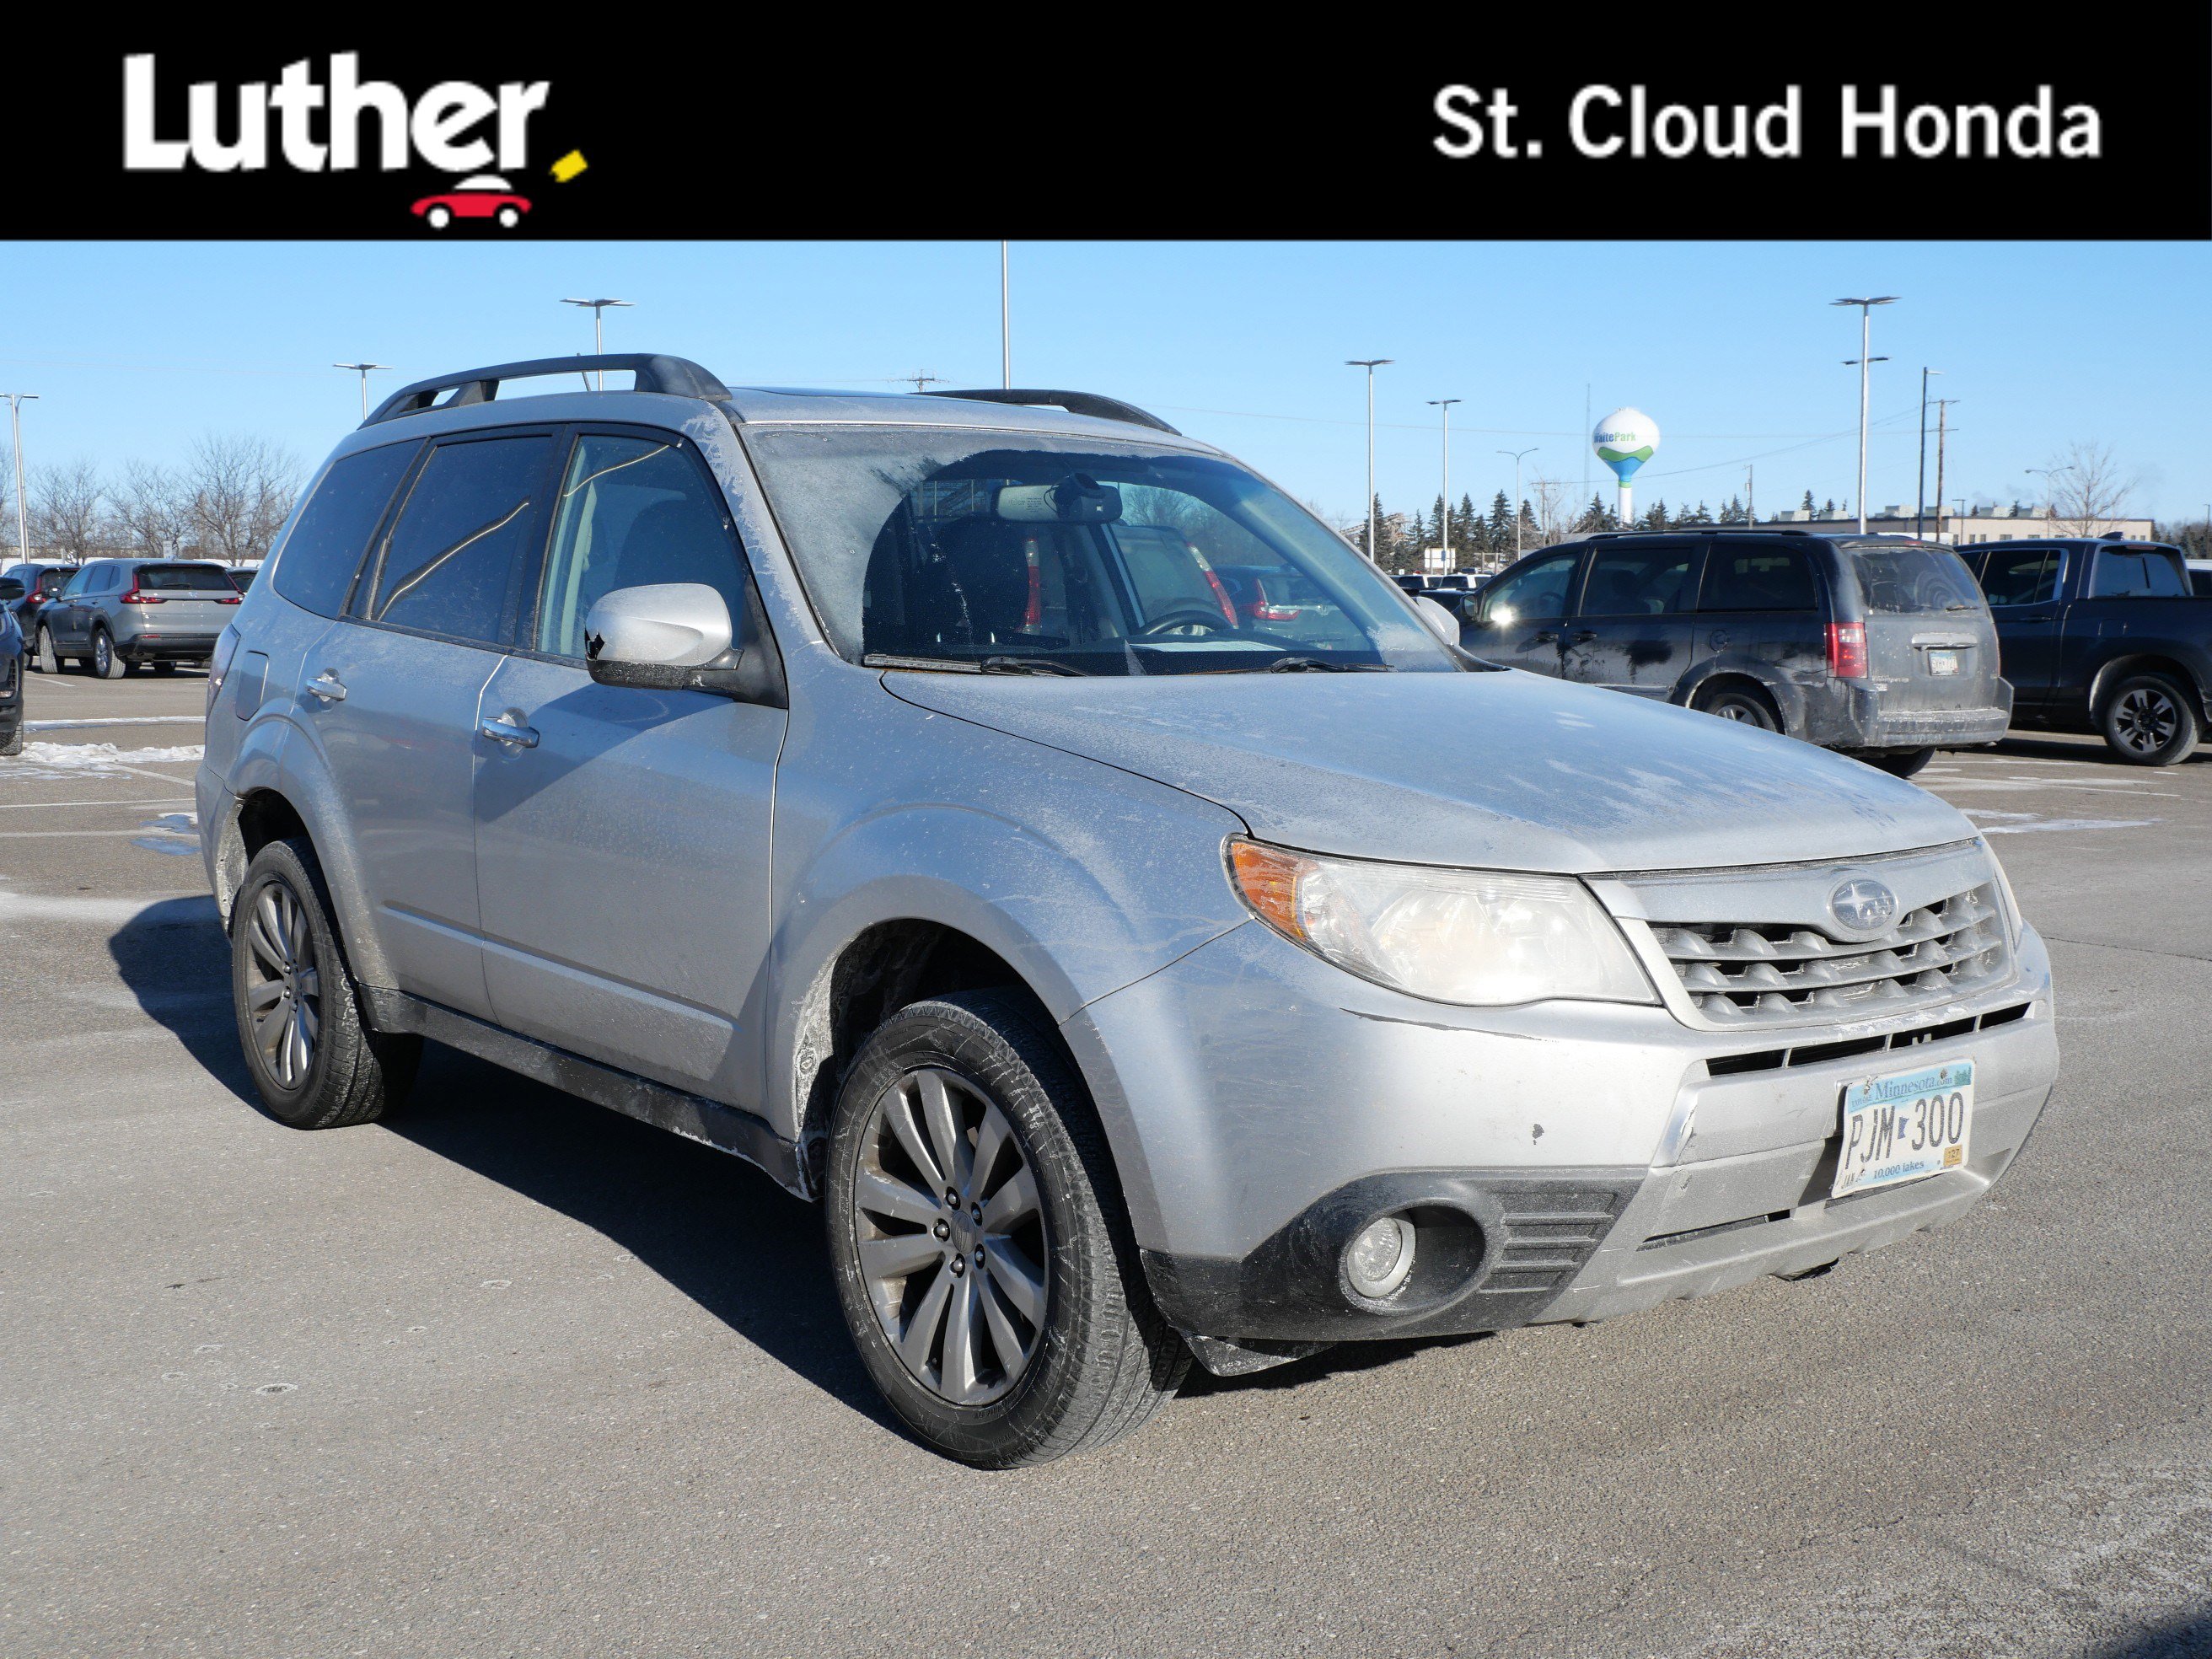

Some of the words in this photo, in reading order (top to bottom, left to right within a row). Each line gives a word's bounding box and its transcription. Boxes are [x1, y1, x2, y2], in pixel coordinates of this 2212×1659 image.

[1844, 1105, 1896, 1170] PJM
[1911, 1092, 1964, 1151] 300
[1873, 1164, 1901, 1178] 10,000
[1902, 1161, 1925, 1172] lakes
